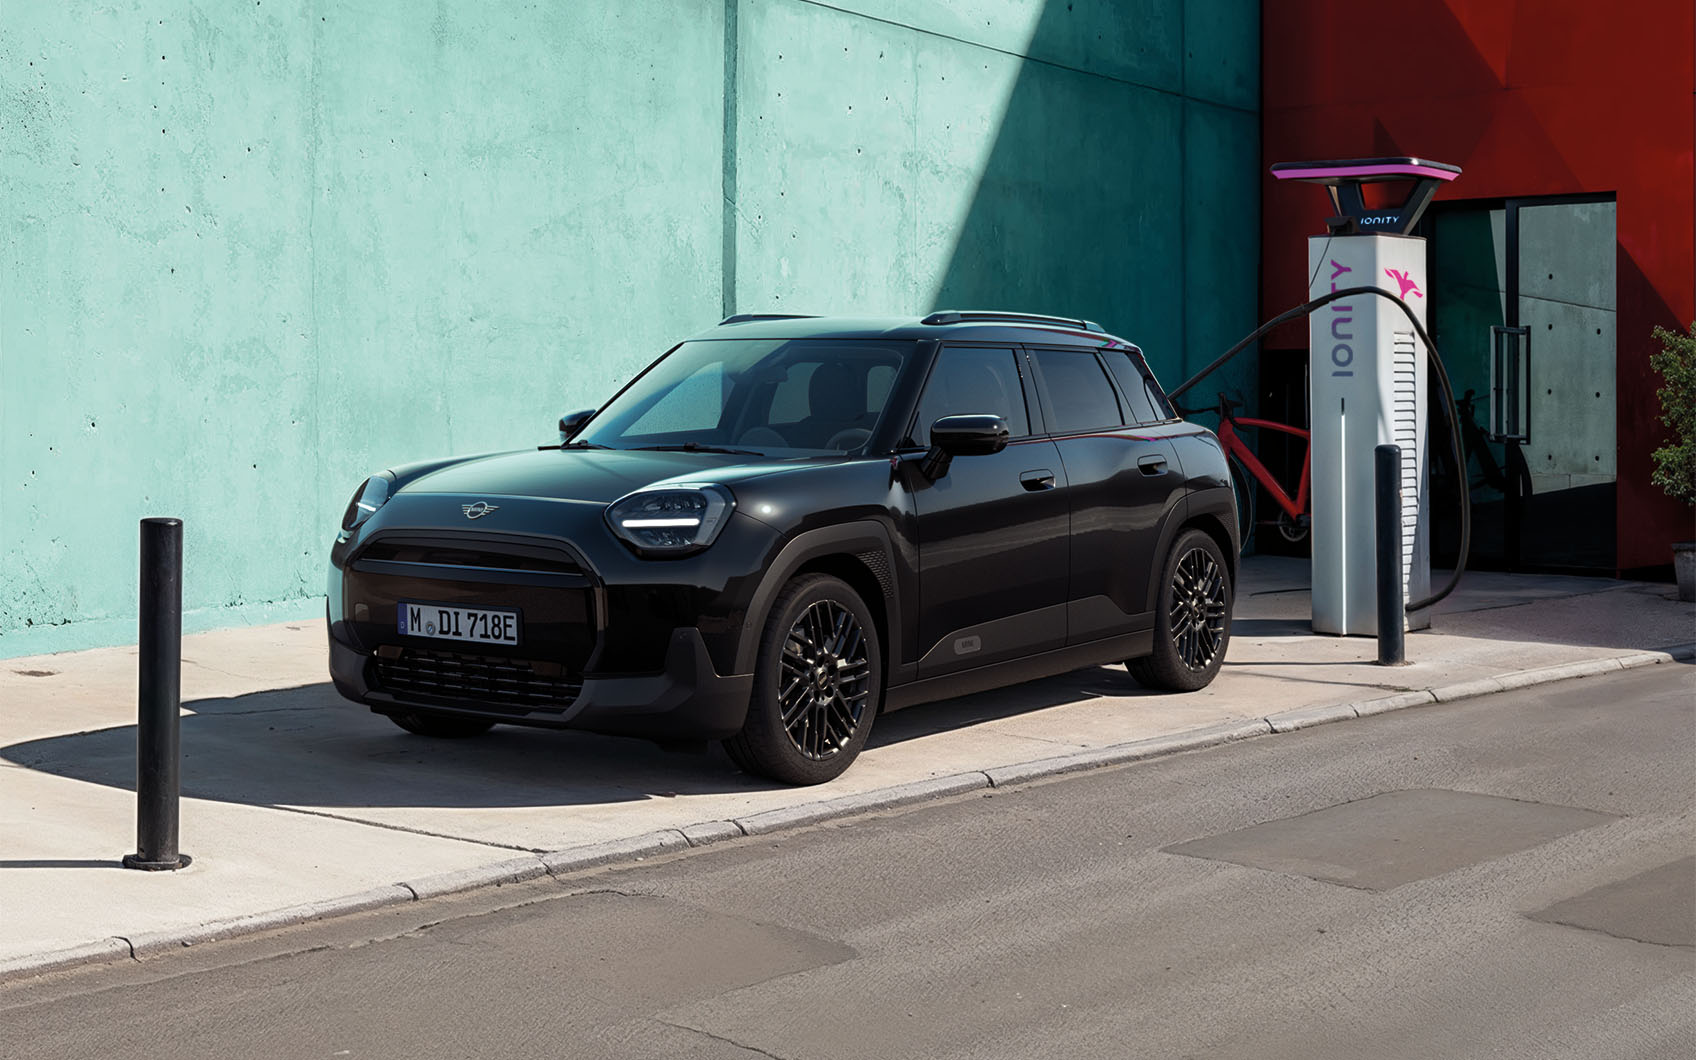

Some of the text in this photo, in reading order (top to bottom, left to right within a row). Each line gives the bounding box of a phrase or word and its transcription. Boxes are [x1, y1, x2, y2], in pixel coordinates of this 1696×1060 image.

[1361, 216, 1400, 225] IONITY
[410, 606, 516, 642] M DI 718E
